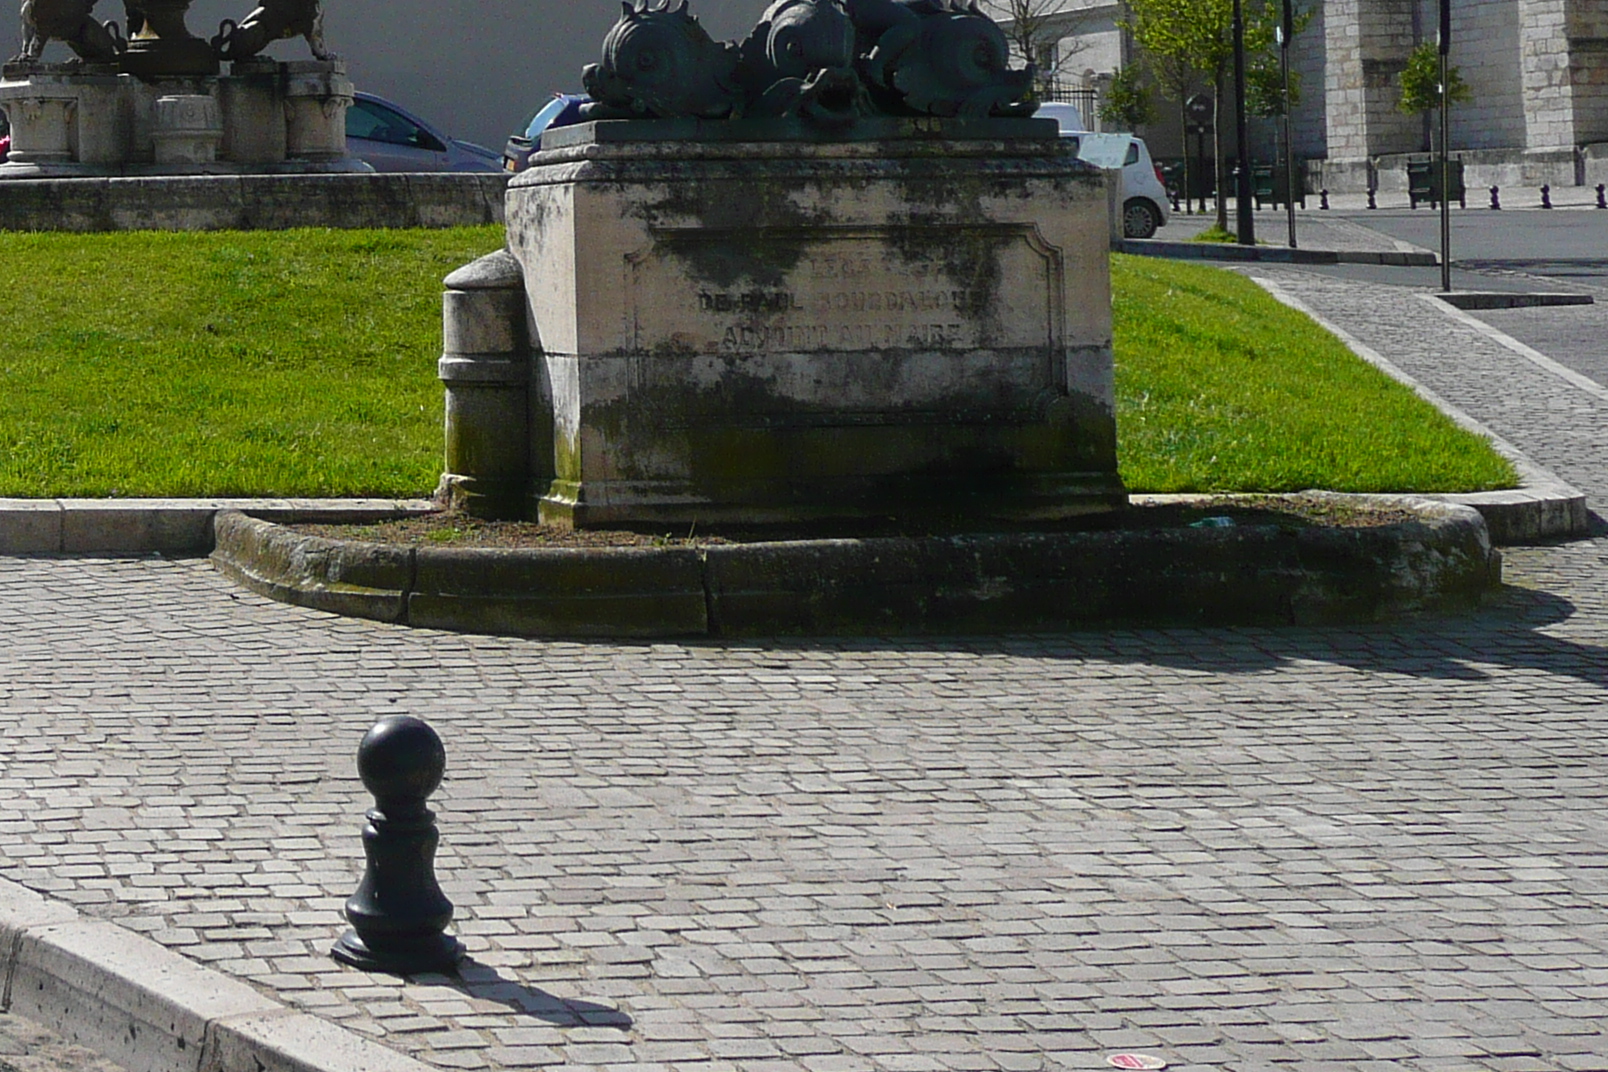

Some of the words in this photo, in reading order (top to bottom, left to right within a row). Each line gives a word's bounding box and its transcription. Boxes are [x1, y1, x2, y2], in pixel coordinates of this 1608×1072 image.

[698, 291, 729, 311] DE
[741, 291, 803, 311] PAUL
[722, 325, 829, 348] ADJOINT
